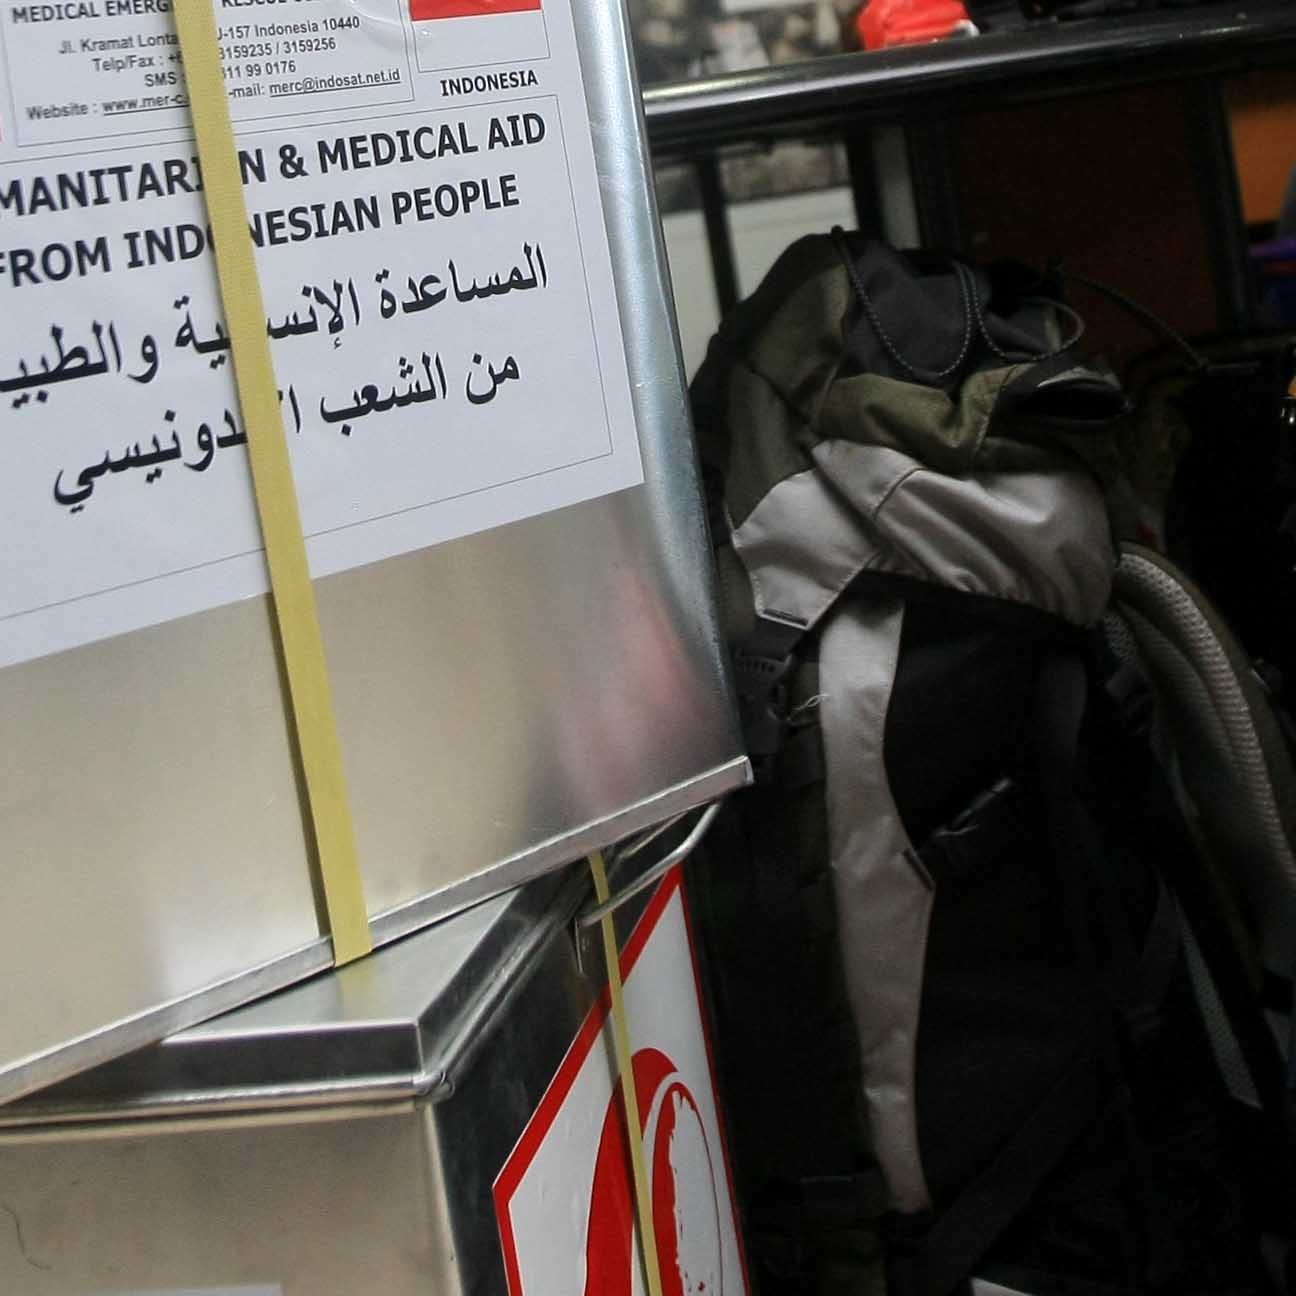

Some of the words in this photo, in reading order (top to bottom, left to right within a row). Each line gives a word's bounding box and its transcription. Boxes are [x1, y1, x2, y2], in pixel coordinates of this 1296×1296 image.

[12, 1, 100, 23] MEDICAL
[58, 40, 76, 54] Jl.
[80, 37, 134, 52] Kramat
[217, 25, 250, 40] J-157
[255, 20, 319, 37] Indonesia
[322, 16, 360, 31] 10440
[92, 54, 156, 72] Telp/Fax
[218, 43, 272, 61] 3159235
[284, 37, 336, 55] 3159256
[144, 71, 177, 87] SMS
[245, 63, 261, 77] 99
[265, 60, 296, 75] 0176
[26, 103, 89, 120] Website
[269, 68, 401, 98] merc@indosat.net.id
[440, 69, 538, 96] INDONESIA
[278, 143, 308, 179] &
[317, 121, 478, 174] MEDICAL
[488, 112, 546, 149] AID
[124, 195, 381, 269] INDNESIAN
[392, 174, 520, 225] PEOPLE
[375, 241, 548, 320] المساعدة
[320, 351, 448, 437] الشعب
[465, 353, 520, 405] من
